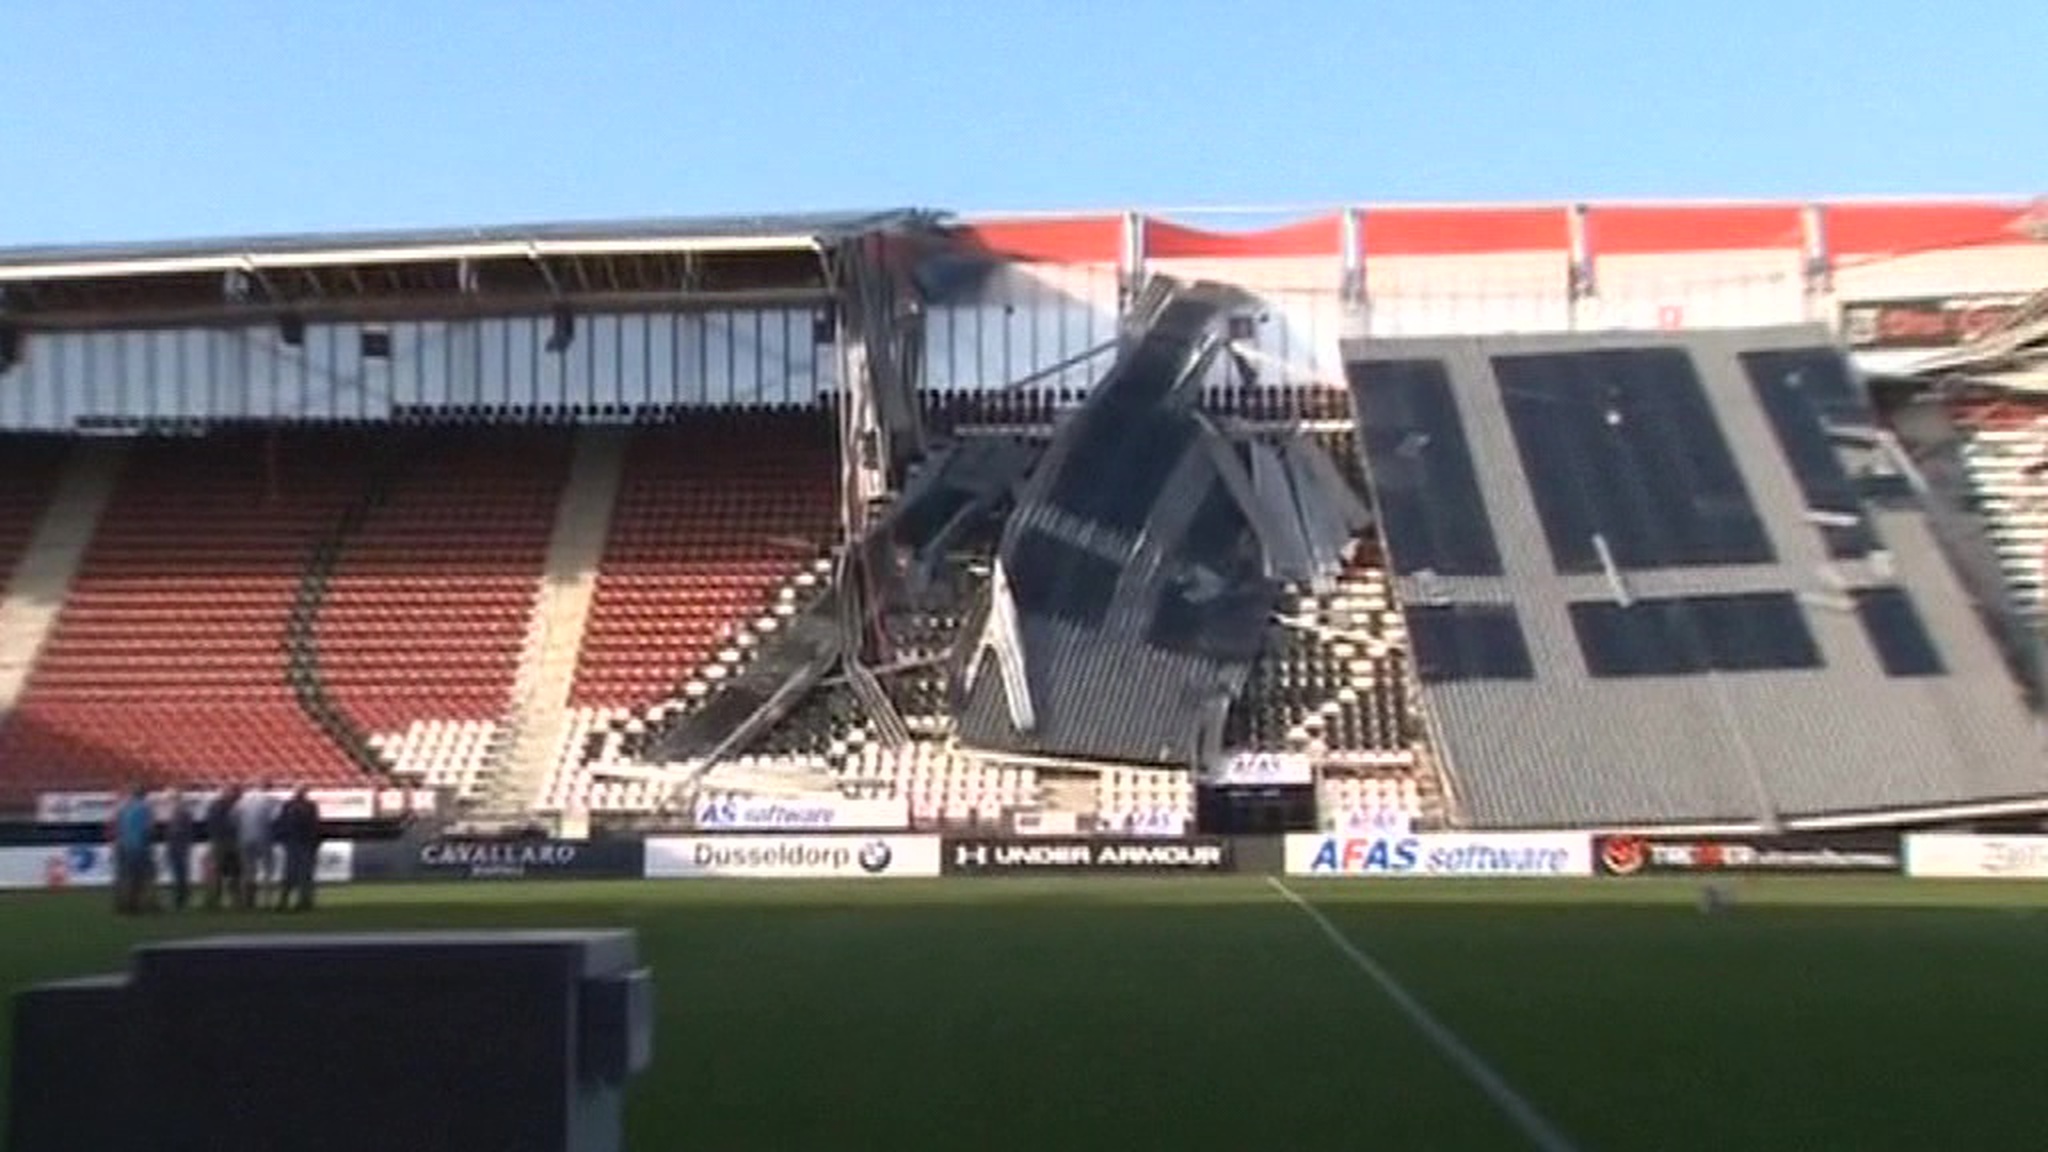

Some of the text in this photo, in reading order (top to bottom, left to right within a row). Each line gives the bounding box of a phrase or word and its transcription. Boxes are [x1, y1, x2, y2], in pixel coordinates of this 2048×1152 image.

[744, 804, 835, 825] software
[421, 844, 575, 865] CAVALLARO
[694, 842, 849, 869] Dusseldorp
[995, 846, 1221, 865] UNDER ARMOUR
[1311, 838, 1569, 870] AFAS software
